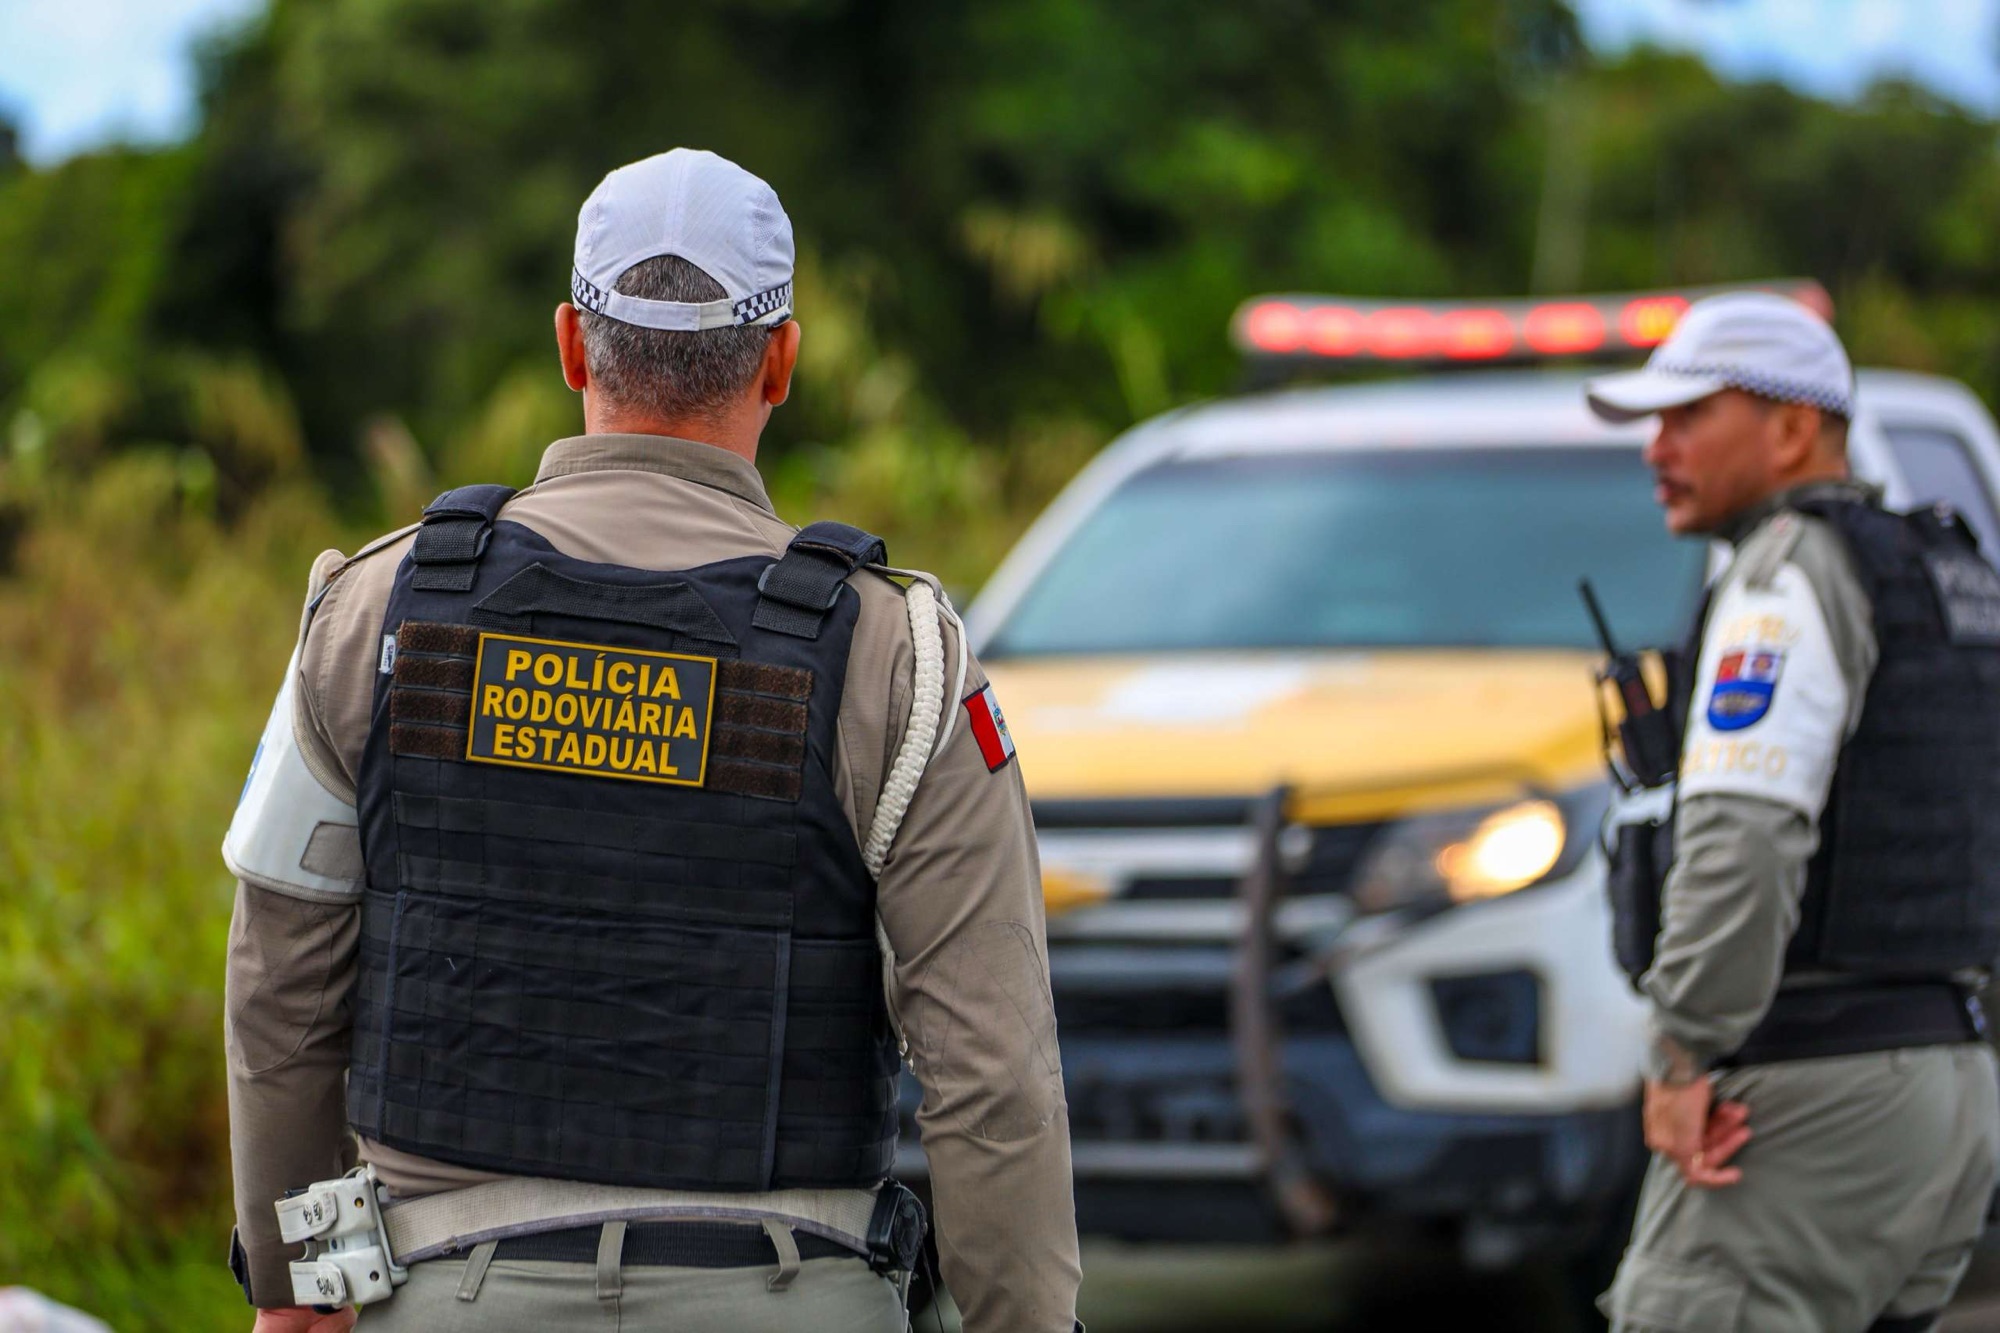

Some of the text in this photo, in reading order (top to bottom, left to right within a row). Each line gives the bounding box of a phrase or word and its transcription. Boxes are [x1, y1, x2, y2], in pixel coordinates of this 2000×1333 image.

[505, 650, 681, 700] POLÍCIA
[482, 685, 697, 740] RODOVIÁRIA
[493, 724, 678, 775] ESTADUAL
